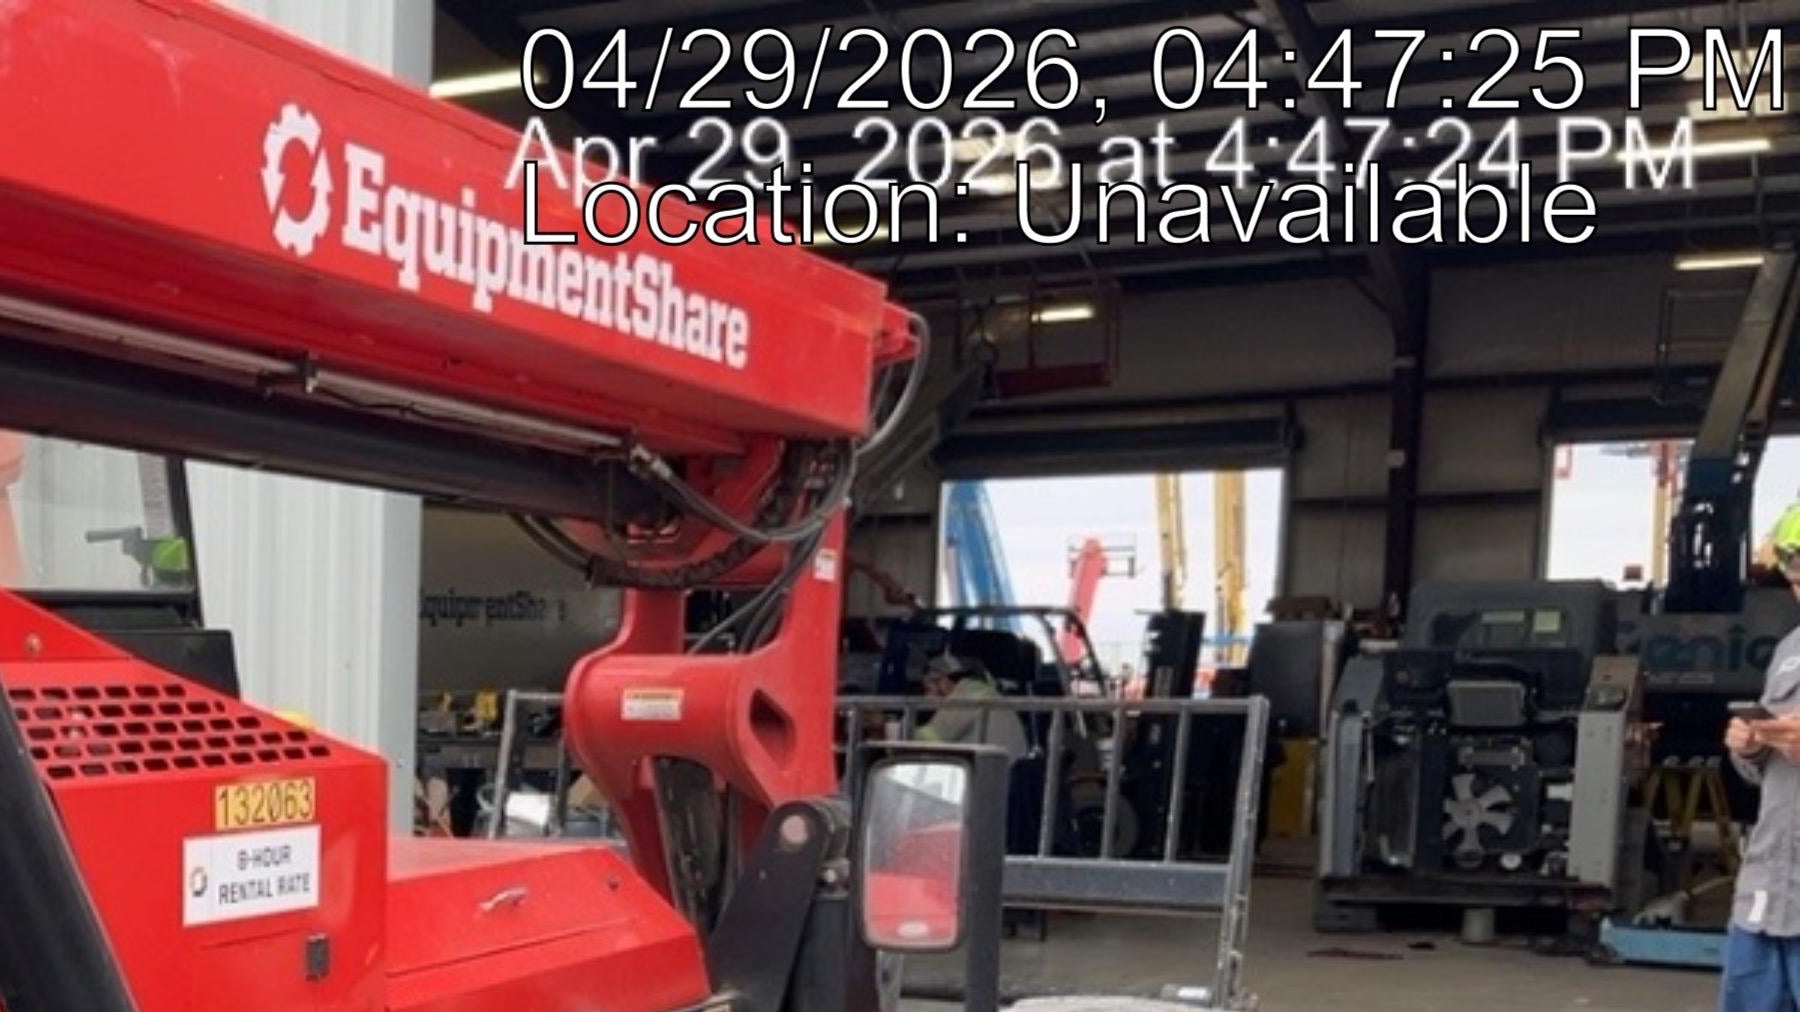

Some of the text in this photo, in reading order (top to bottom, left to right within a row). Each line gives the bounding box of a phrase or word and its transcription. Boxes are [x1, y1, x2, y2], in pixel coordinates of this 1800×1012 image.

[341, 142, 750, 371] EquipmentShare
[218, 779, 313, 826] 132063
[237, 845, 291, 871] 8-HOUR
[218, 873, 310, 905] RENTAL RATE
